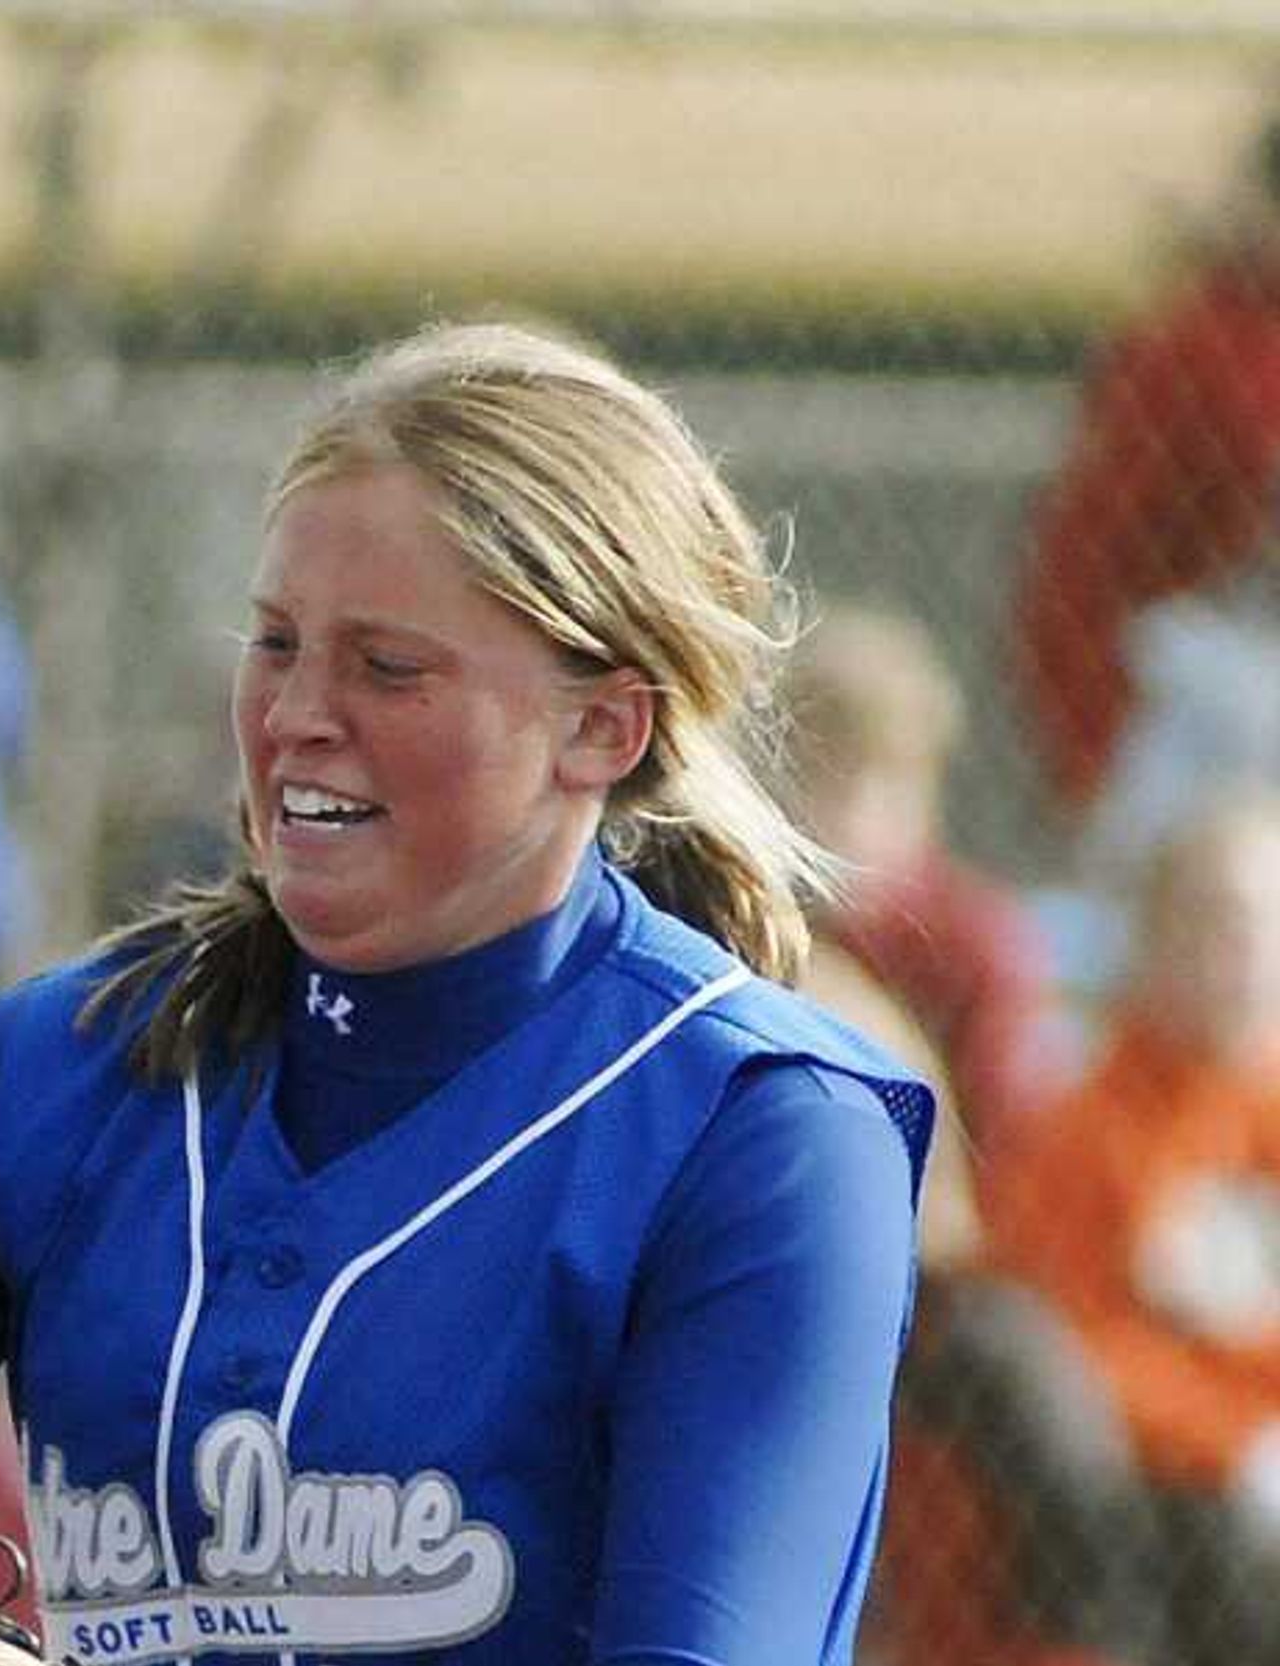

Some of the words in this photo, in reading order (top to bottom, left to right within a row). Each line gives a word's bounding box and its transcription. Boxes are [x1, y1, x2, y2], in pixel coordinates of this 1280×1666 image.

[31, 1443, 164, 1600] tre
[195, 1409, 462, 1586] Dame
[74, 1613, 173, 1656] SOFT
[194, 1604, 290, 1639] BALL
